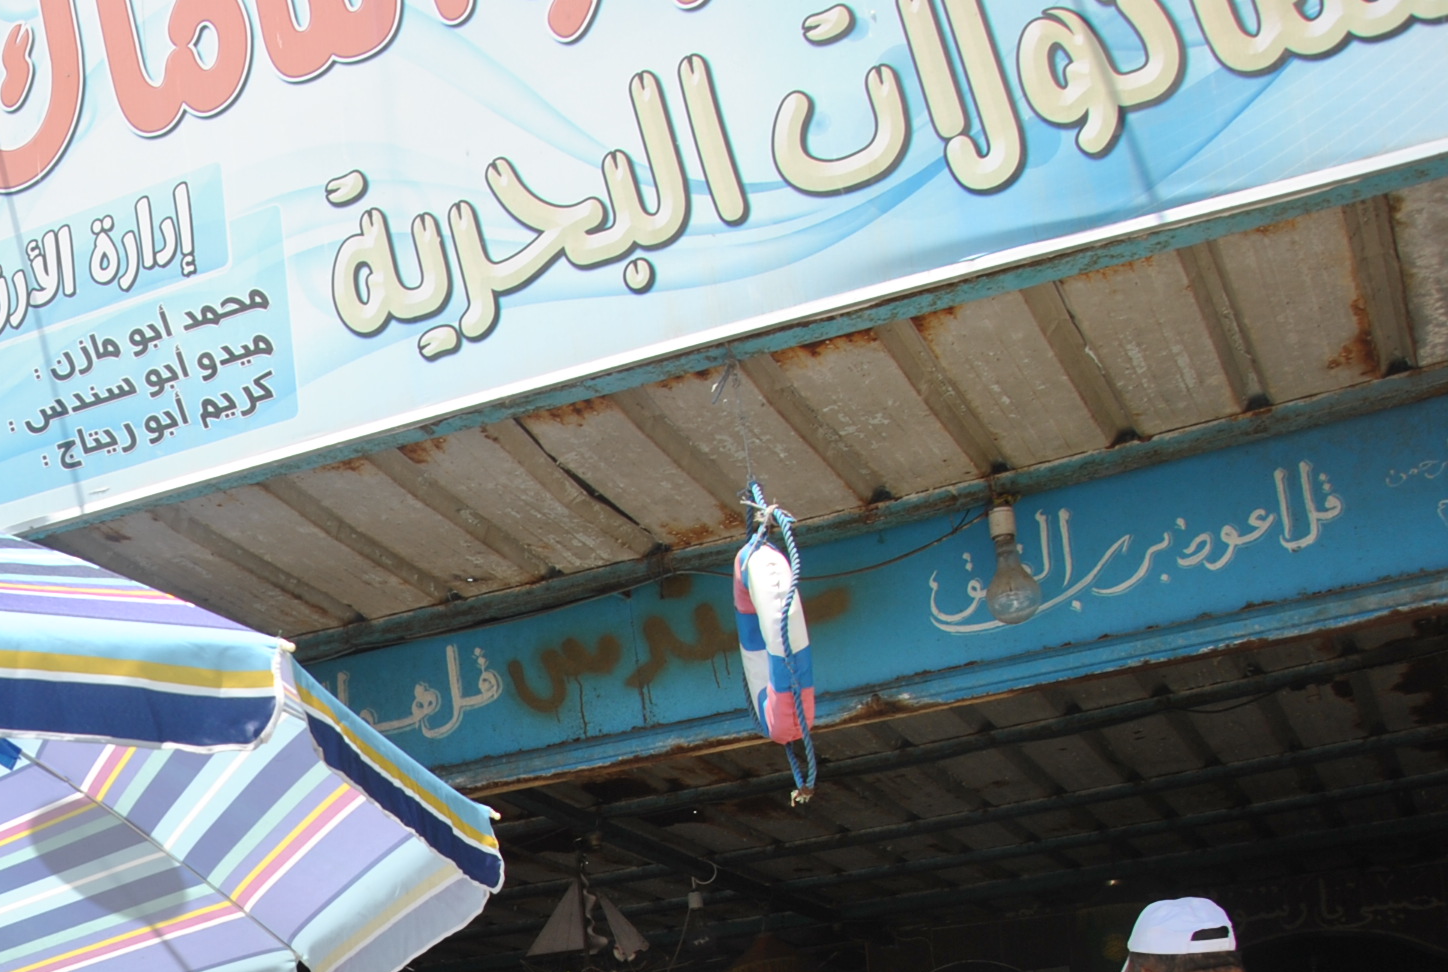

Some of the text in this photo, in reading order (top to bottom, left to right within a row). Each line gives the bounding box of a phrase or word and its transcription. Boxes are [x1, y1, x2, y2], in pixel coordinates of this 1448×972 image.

[326, 53, 749, 362] البحرية
[89, 181, 197, 292] إدارة
[128, 304, 174, 357] أبو
[182, 288, 270, 332] محمد
[50, 333, 122, 381] مازن
[144, 345, 190, 398] أبو
[197, 334, 274, 381] ميدو
[24, 376, 138, 434] سندس
[143, 391, 189, 445] أبو
[199, 370, 275, 429] كريم
[56, 422, 138, 470] ريتاج
[930, 508, 1073, 624] الفق
